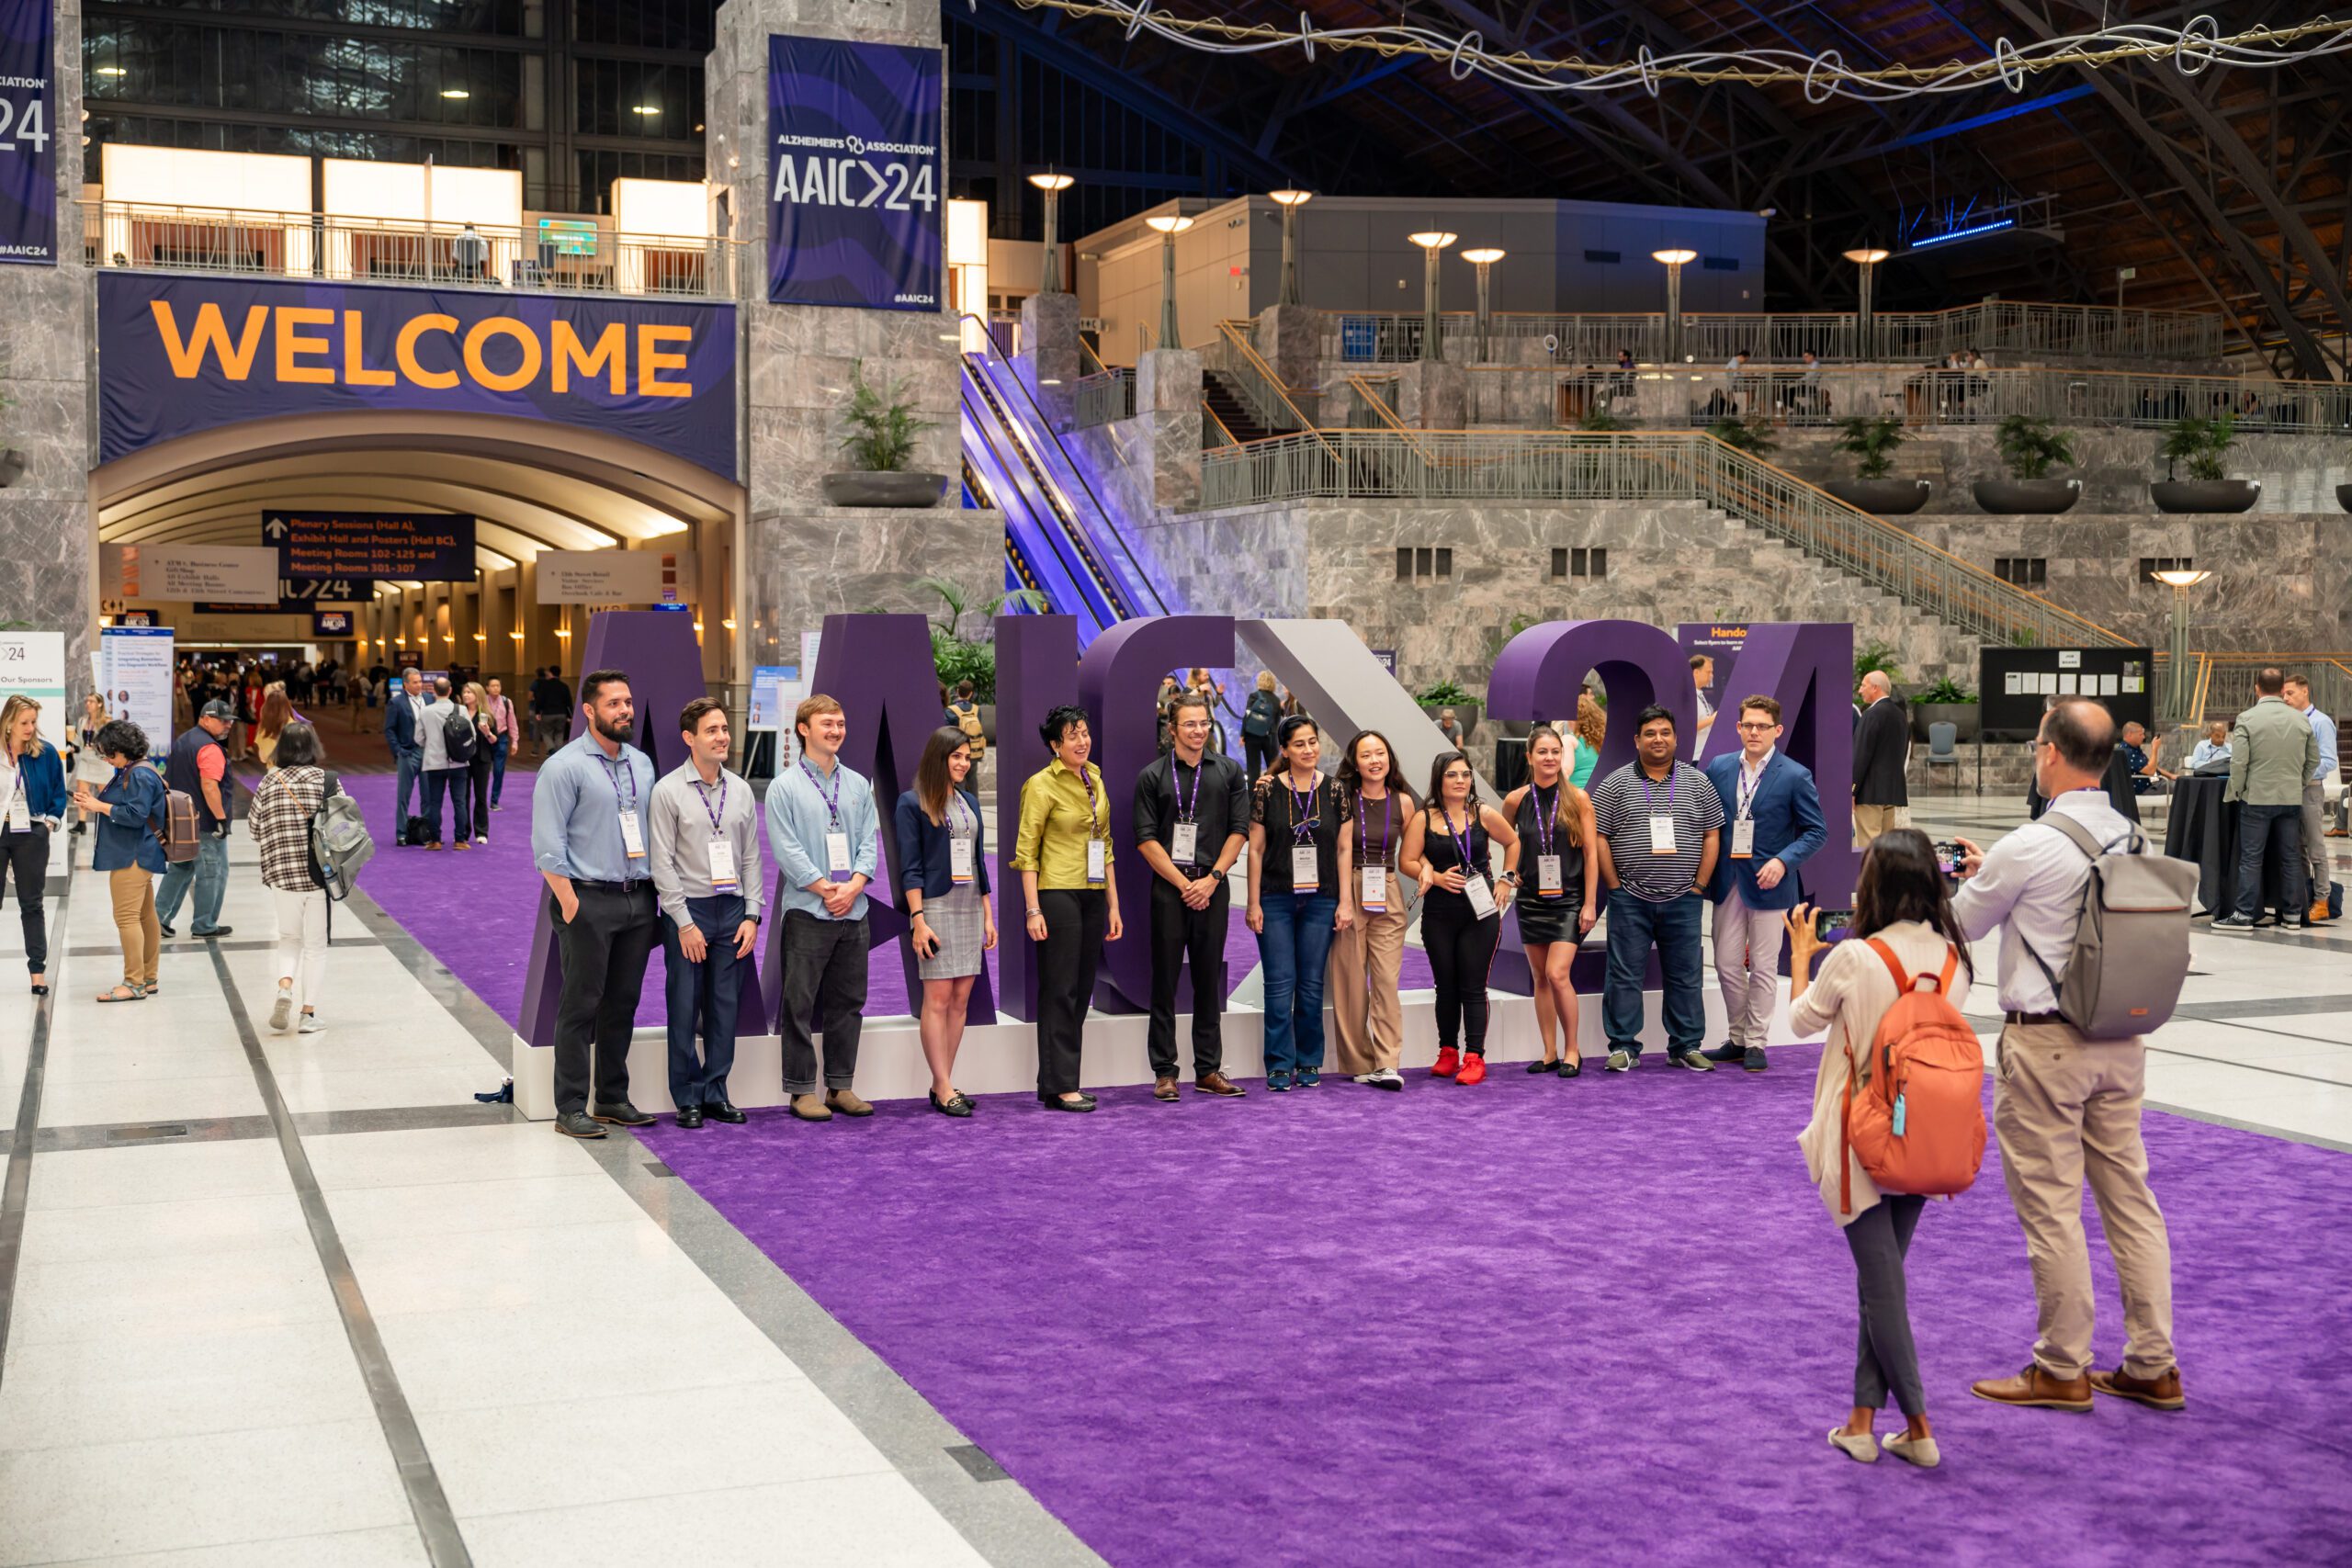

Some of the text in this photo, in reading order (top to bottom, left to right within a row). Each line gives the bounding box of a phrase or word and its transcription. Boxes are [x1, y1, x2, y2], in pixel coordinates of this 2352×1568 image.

[778, 134, 845, 149] ALZHEIMER'S
[894, 293, 935, 304] #AAIC24
[151, 299, 693, 398] WELCOME
[290, 519, 330, 531] Plenary
[332, 520, 374, 530] Sessions
[377, 520, 400, 531] (Hall
[290, 534, 326, 544] Exhibit
[329, 535, 349, 544] Hall
[351, 536, 369, 544] and
[371, 536, 409, 545] Posters
[411, 536, 434, 547] (Hall
[290, 547, 436, 559] Meeting Rooms 102-125 and
[290, 562, 416, 574] Meeting Rooms 301-307
[17, 676, 53, 684] Sponsors
